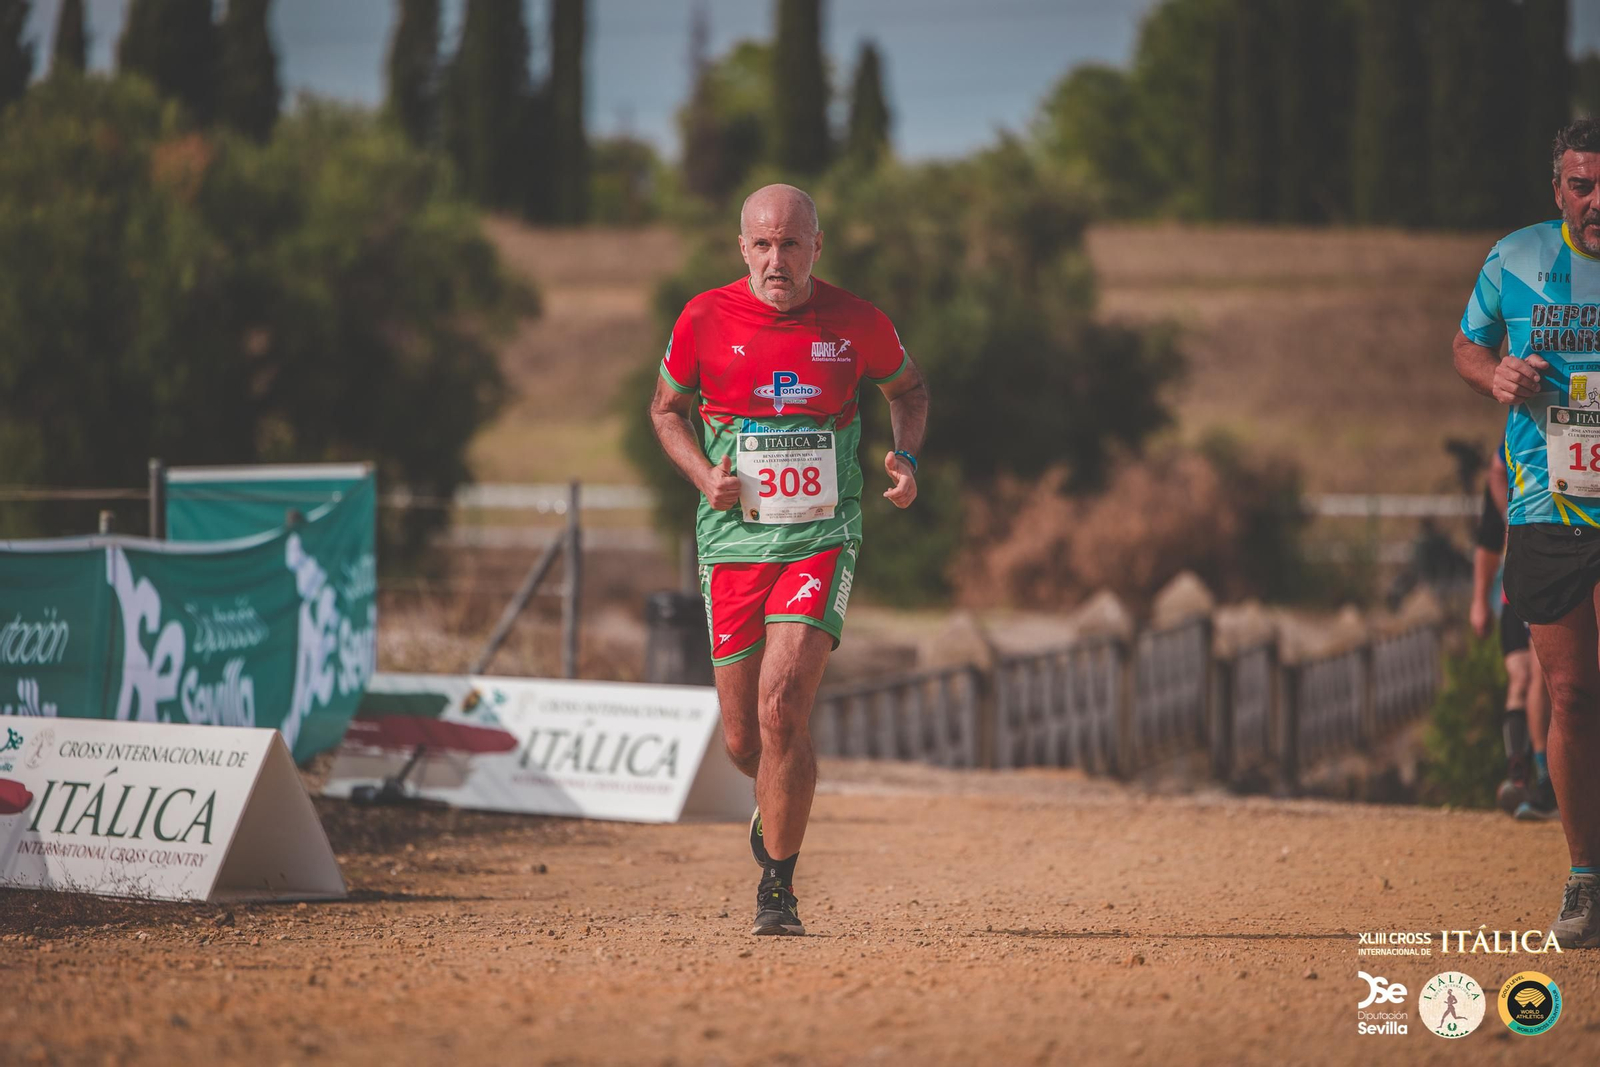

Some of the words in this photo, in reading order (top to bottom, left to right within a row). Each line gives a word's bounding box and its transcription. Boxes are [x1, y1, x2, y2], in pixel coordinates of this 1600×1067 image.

[1537, 271, 1571, 284] GOBIK
[1530, 304, 1600, 328] DEPO
[811, 341, 836, 358] ATARFE
[773, 370, 813, 397] Poncho
[764, 435, 811, 448] ITÁLICA
[759, 467, 822, 497] 308
[58, 740, 104, 760] CROSS
[105, 743, 223, 767] INTERNACIONAL
[226, 750, 250, 768] DE
[515, 717, 682, 779] ITÁLICA
[26, 766, 217, 845] ITÁLICA
[17, 839, 109, 862] INTERNATIONAL
[109, 846, 148, 865] CROSS
[149, 848, 209, 868] COUNTRY
